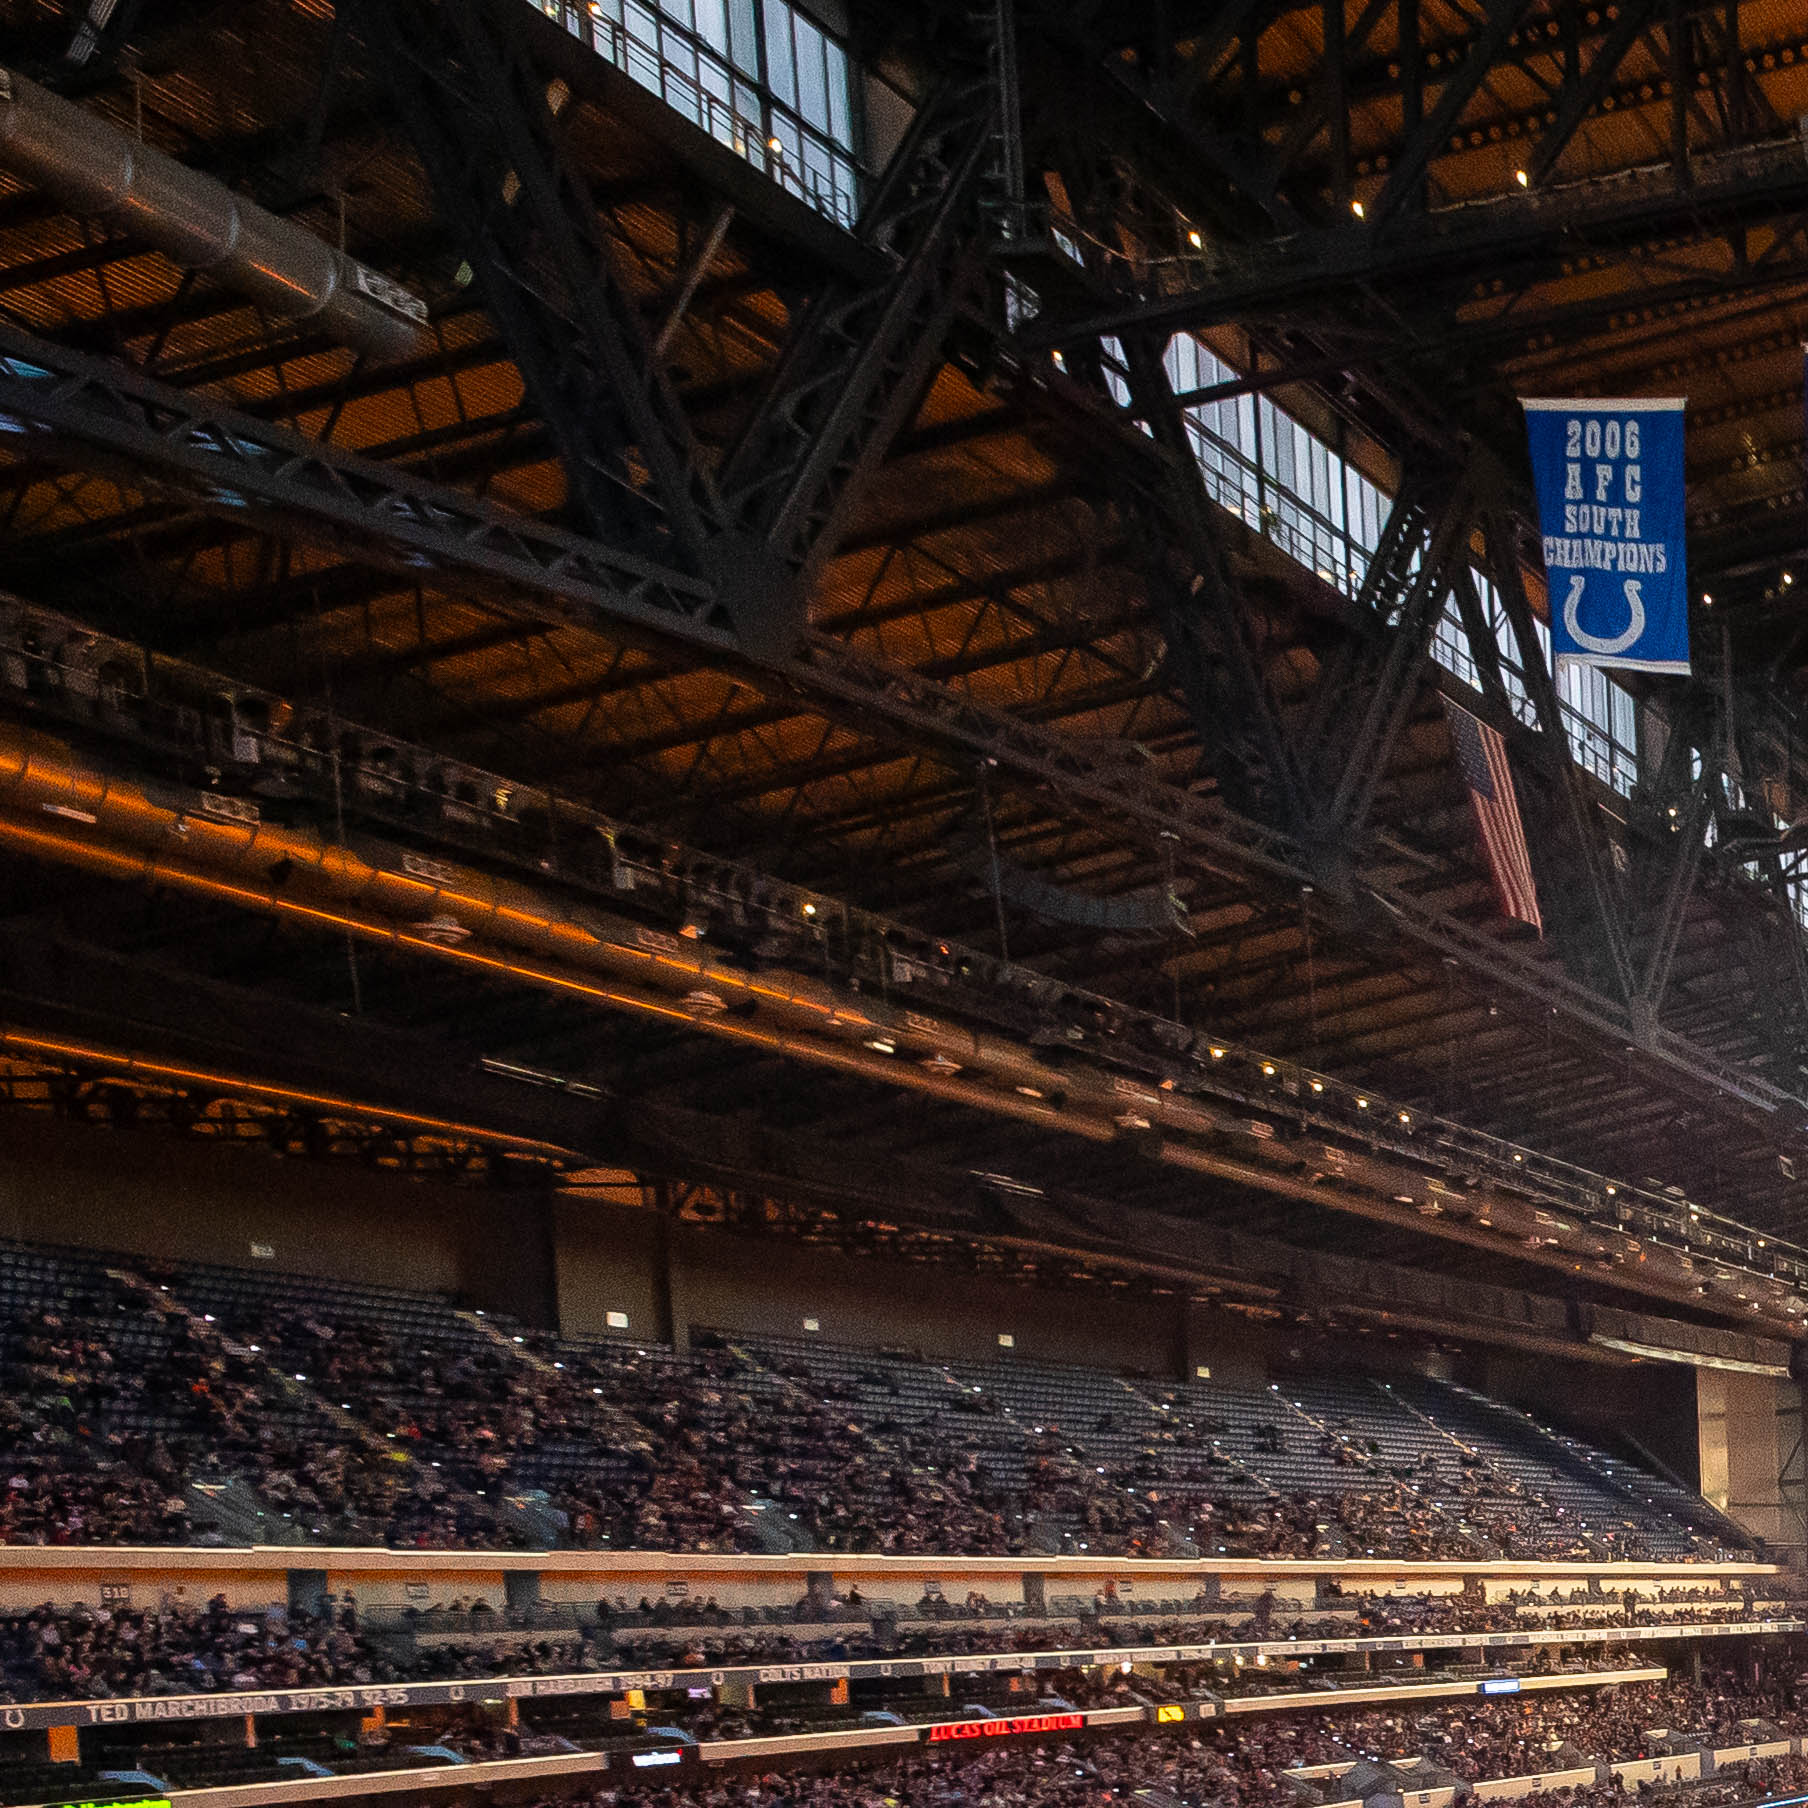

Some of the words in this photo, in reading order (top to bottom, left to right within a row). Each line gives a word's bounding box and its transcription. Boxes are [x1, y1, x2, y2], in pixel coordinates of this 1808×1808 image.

[1566, 421, 1640, 456] 2006
[1565, 505, 1641, 538] SOUTH
[1543, 539, 1666, 573] CHAMPIONS
[760, 1668, 800, 1682] COLTS
[89, 1704, 128, 1722] TED
[135, 1694, 281, 1720] MARCHIBRODA
[931, 1723, 981, 1741] LUCAS
[984, 1720, 1010, 1736] OIL
[1012, 1714, 1083, 1734] STADIUM
